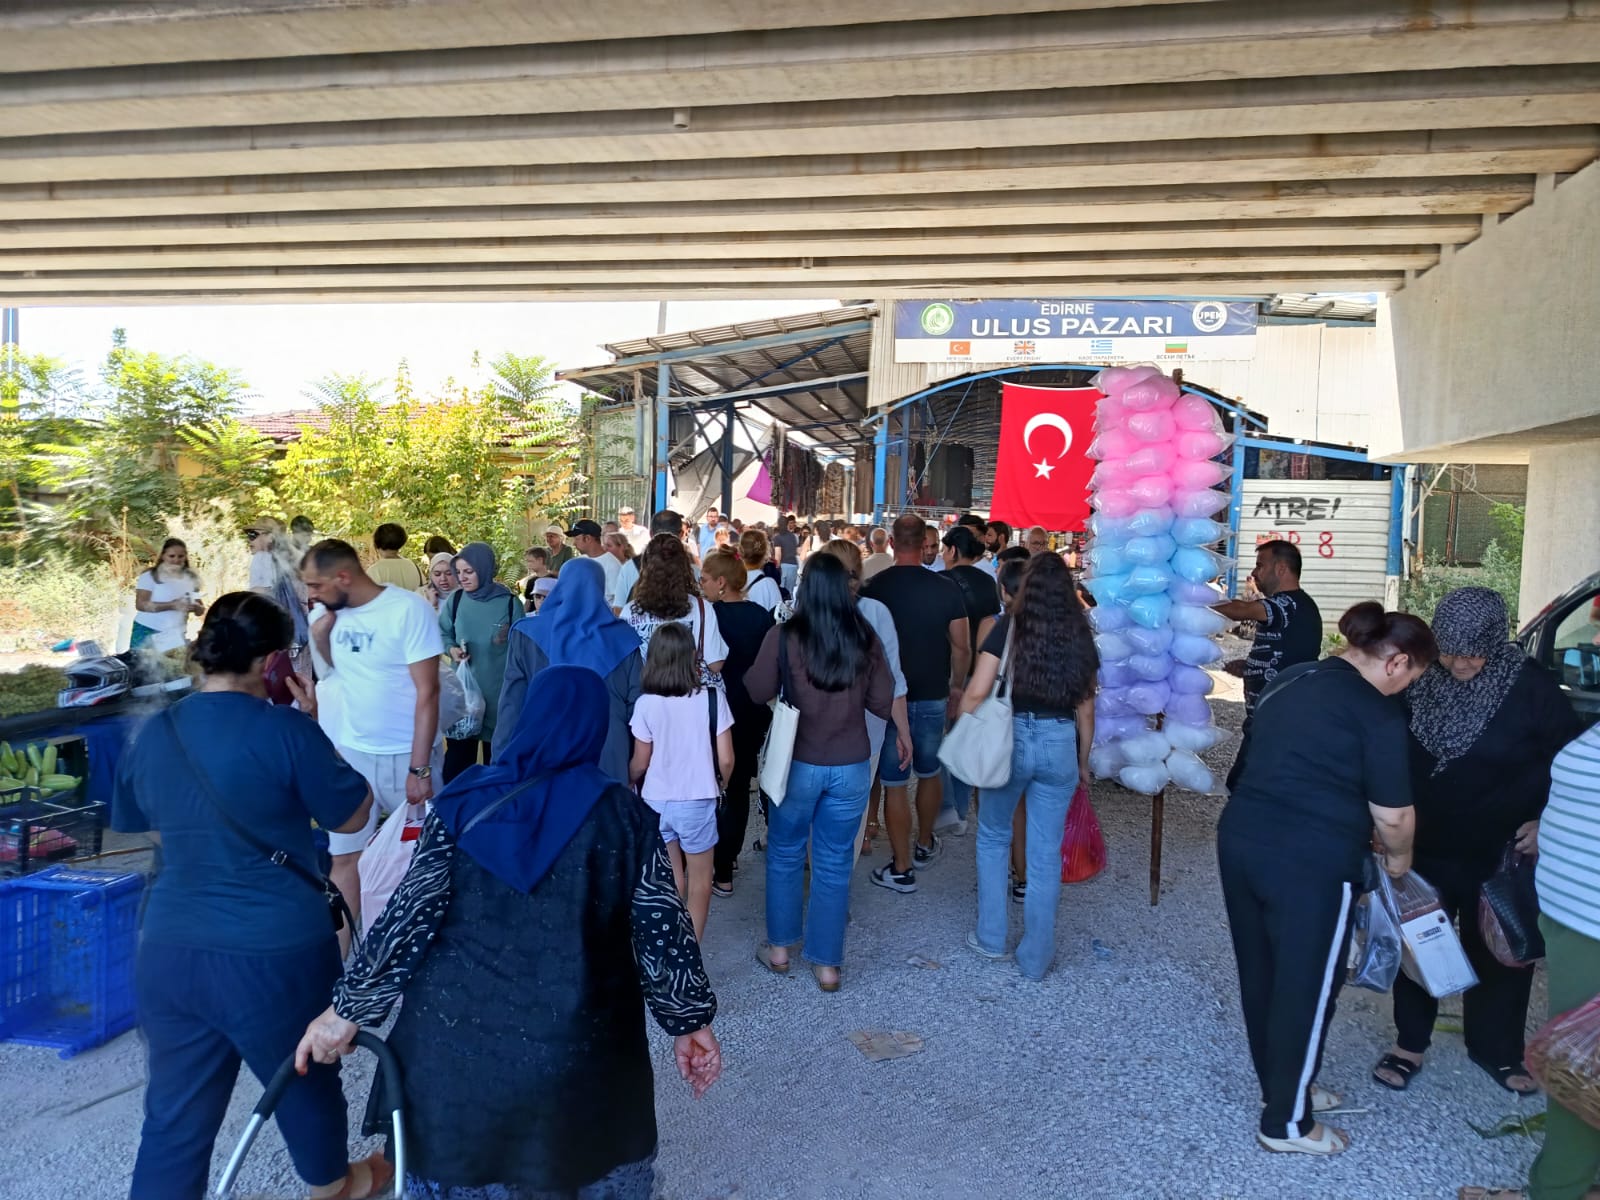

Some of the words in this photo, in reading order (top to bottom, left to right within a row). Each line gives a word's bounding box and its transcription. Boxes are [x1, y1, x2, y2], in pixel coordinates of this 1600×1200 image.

[1041, 302, 1094, 315] EDİRNE
[971, 318, 1050, 336] ULUS
[1061, 317, 1173, 335] PAZARI
[1254, 496, 1341, 520] ATRE!
[1318, 531, 1334, 559] 8
